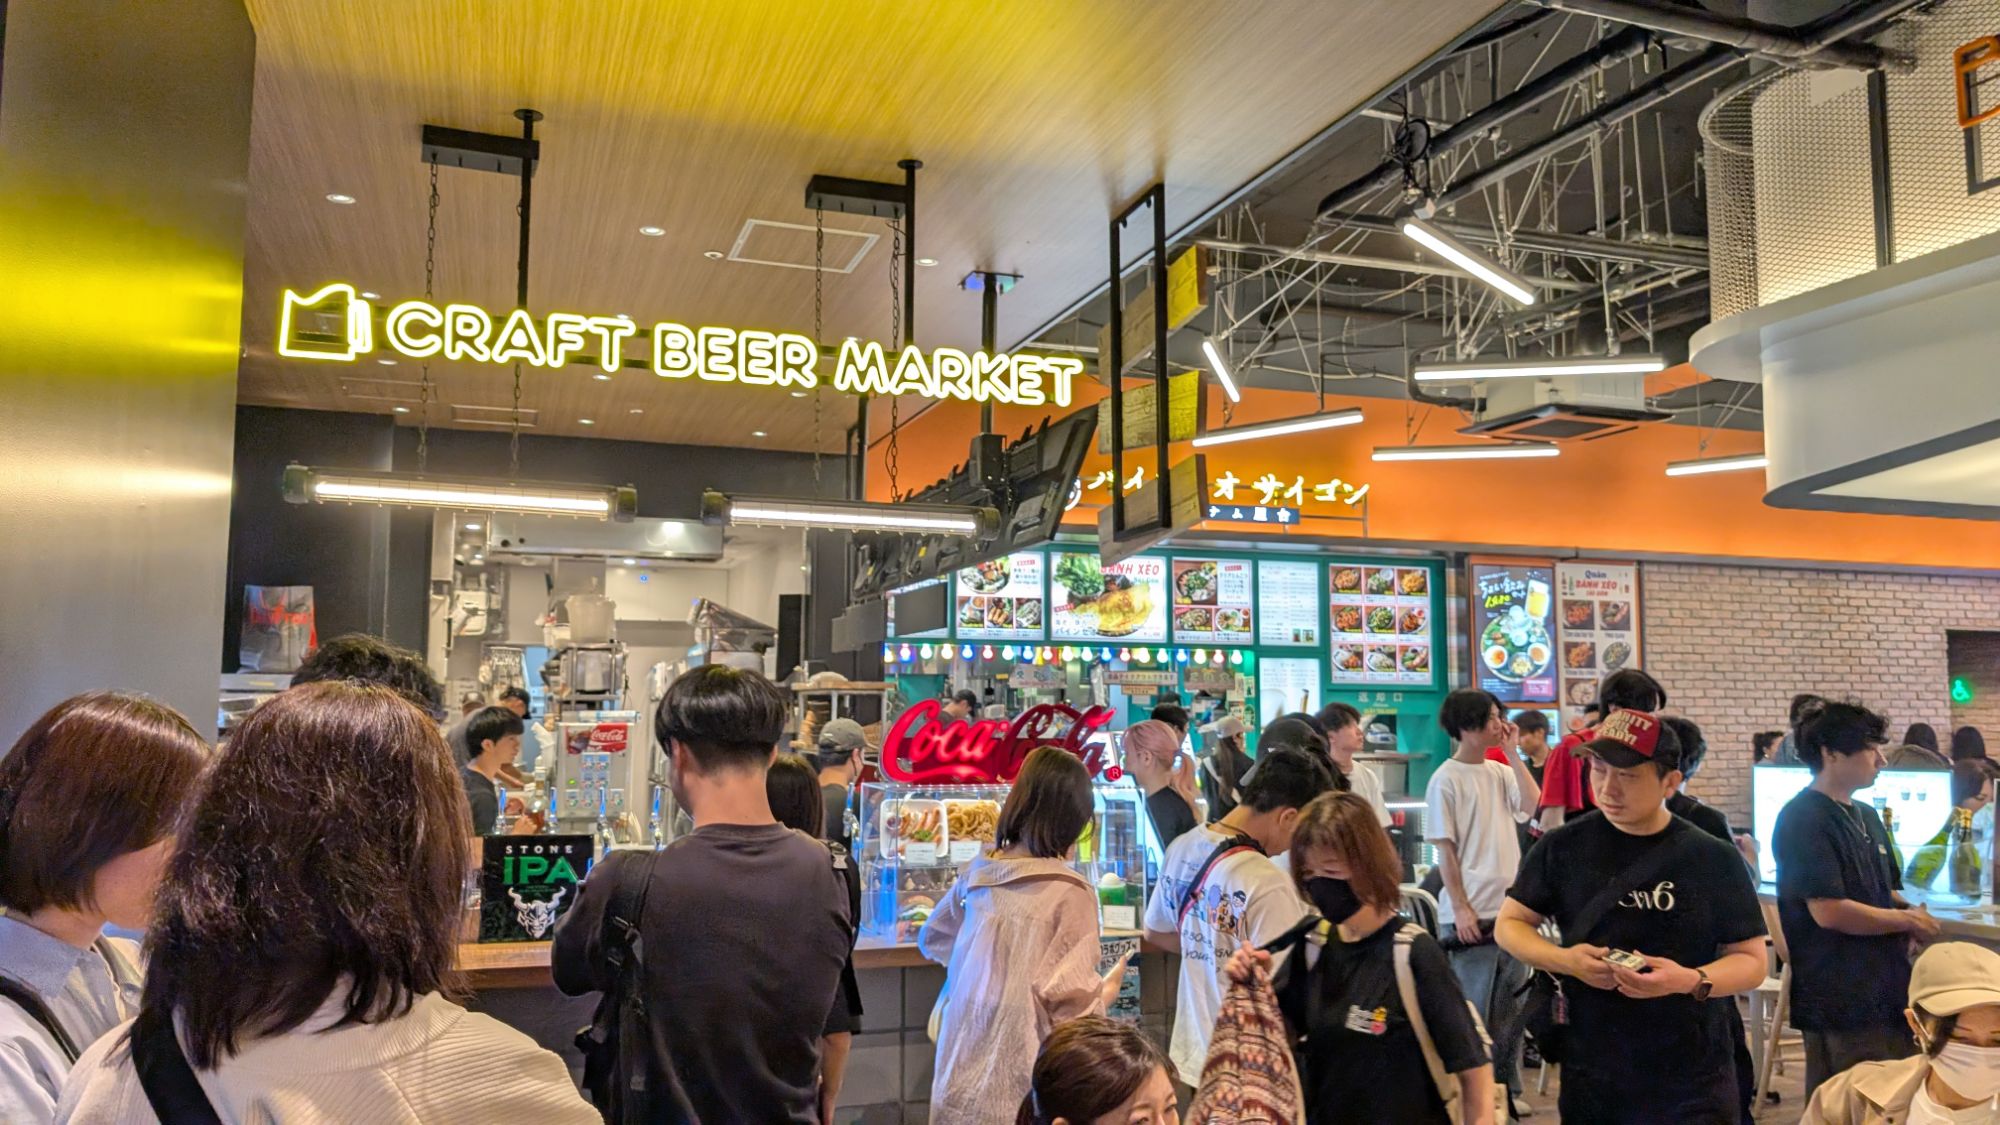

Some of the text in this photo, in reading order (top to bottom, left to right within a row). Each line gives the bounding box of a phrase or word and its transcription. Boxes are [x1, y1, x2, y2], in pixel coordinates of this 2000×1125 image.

[386, 301, 1084, 407] CRAFT BEER MARKET
[879, 698, 1117, 783] Coca-Cla
[503, 856, 579, 886] IPA
[505, 844, 573, 854] STONE
